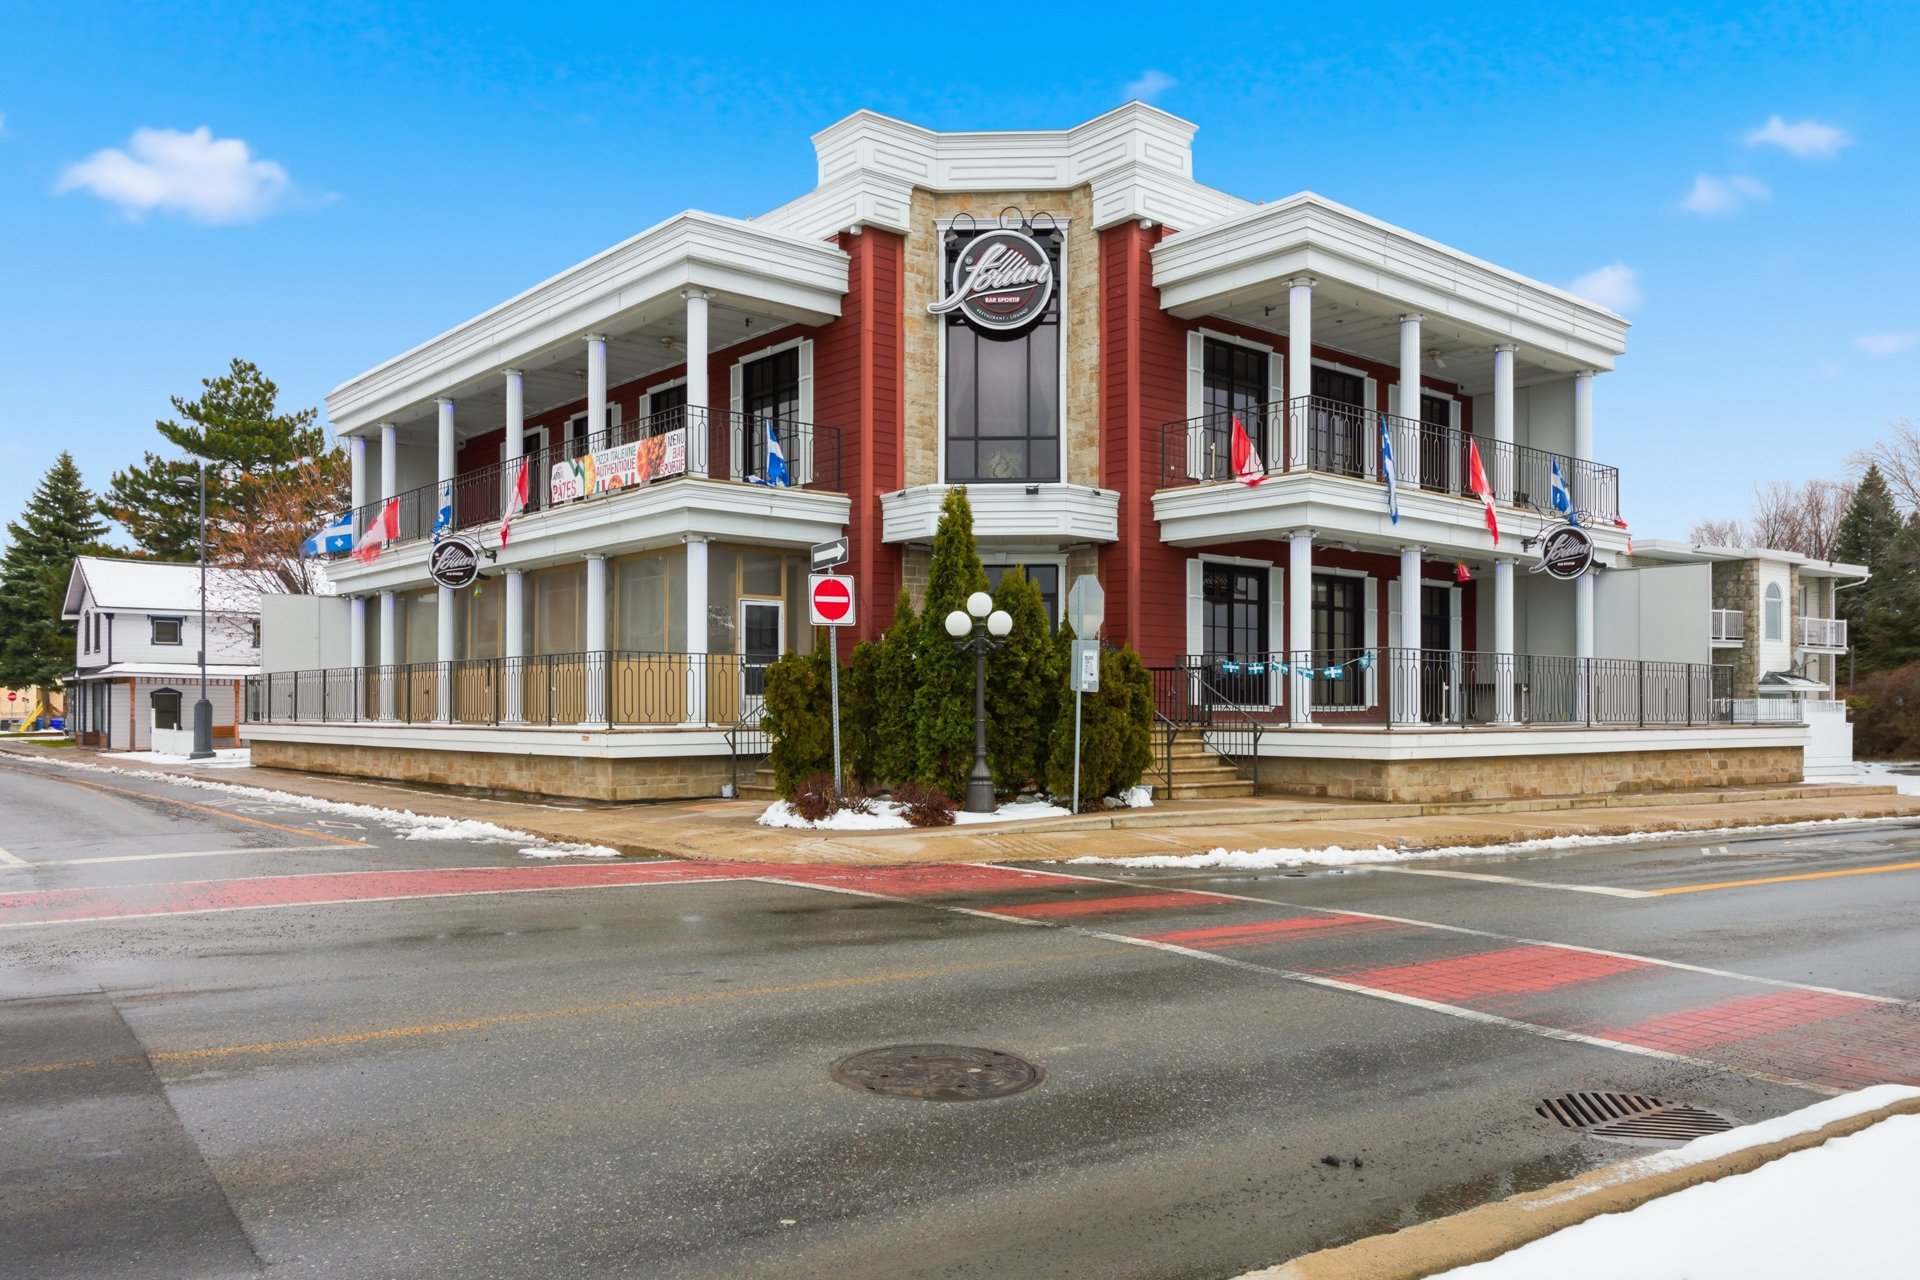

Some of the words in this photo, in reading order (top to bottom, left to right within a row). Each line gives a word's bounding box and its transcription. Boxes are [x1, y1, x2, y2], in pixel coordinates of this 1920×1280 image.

[667, 431, 685, 447] MENU
[596, 452, 609, 465] PIZZA
[610, 445, 637, 461] ITALIENNE
[672, 445, 685, 459] BAR
[596, 457, 636, 477] AUTHENTIQUE
